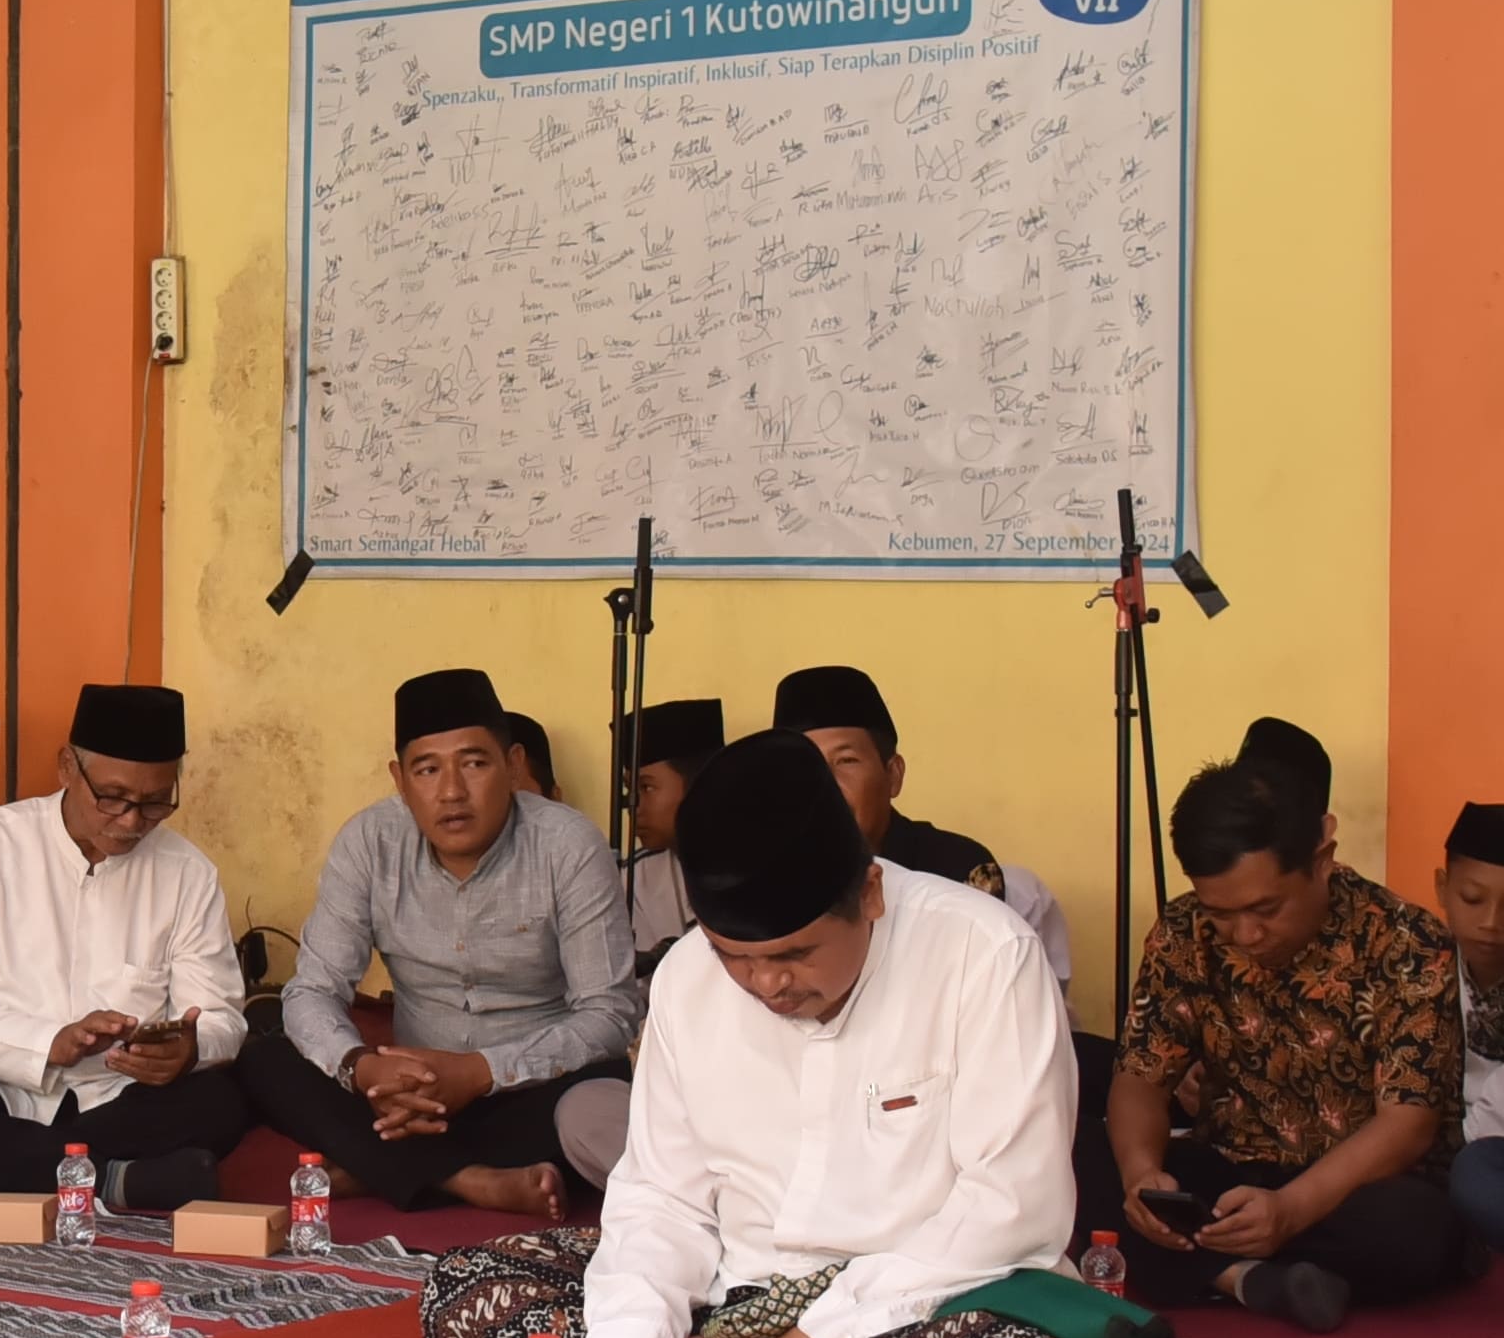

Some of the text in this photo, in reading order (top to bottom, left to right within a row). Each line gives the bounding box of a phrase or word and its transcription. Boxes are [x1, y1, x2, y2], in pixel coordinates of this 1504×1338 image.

[488, 19, 556, 58] SMP
[564, 7, 674, 55] Negeri
[681, 6, 695, 38] 1
[510, 75, 619, 99] Transformatif
[778, 56, 815, 78] Siap
[822, 48, 901, 73] Terapkan
[908, 42, 975, 66] Disiplin
[982, 34, 1041, 57] Positif
[310, 534, 353, 552] Smart
[359, 534, 434, 556] Semangat
[888, 532, 979, 553] Kebumen,
[985, 534, 1006, 551] 27
[1012, 532, 1115, 556] September
